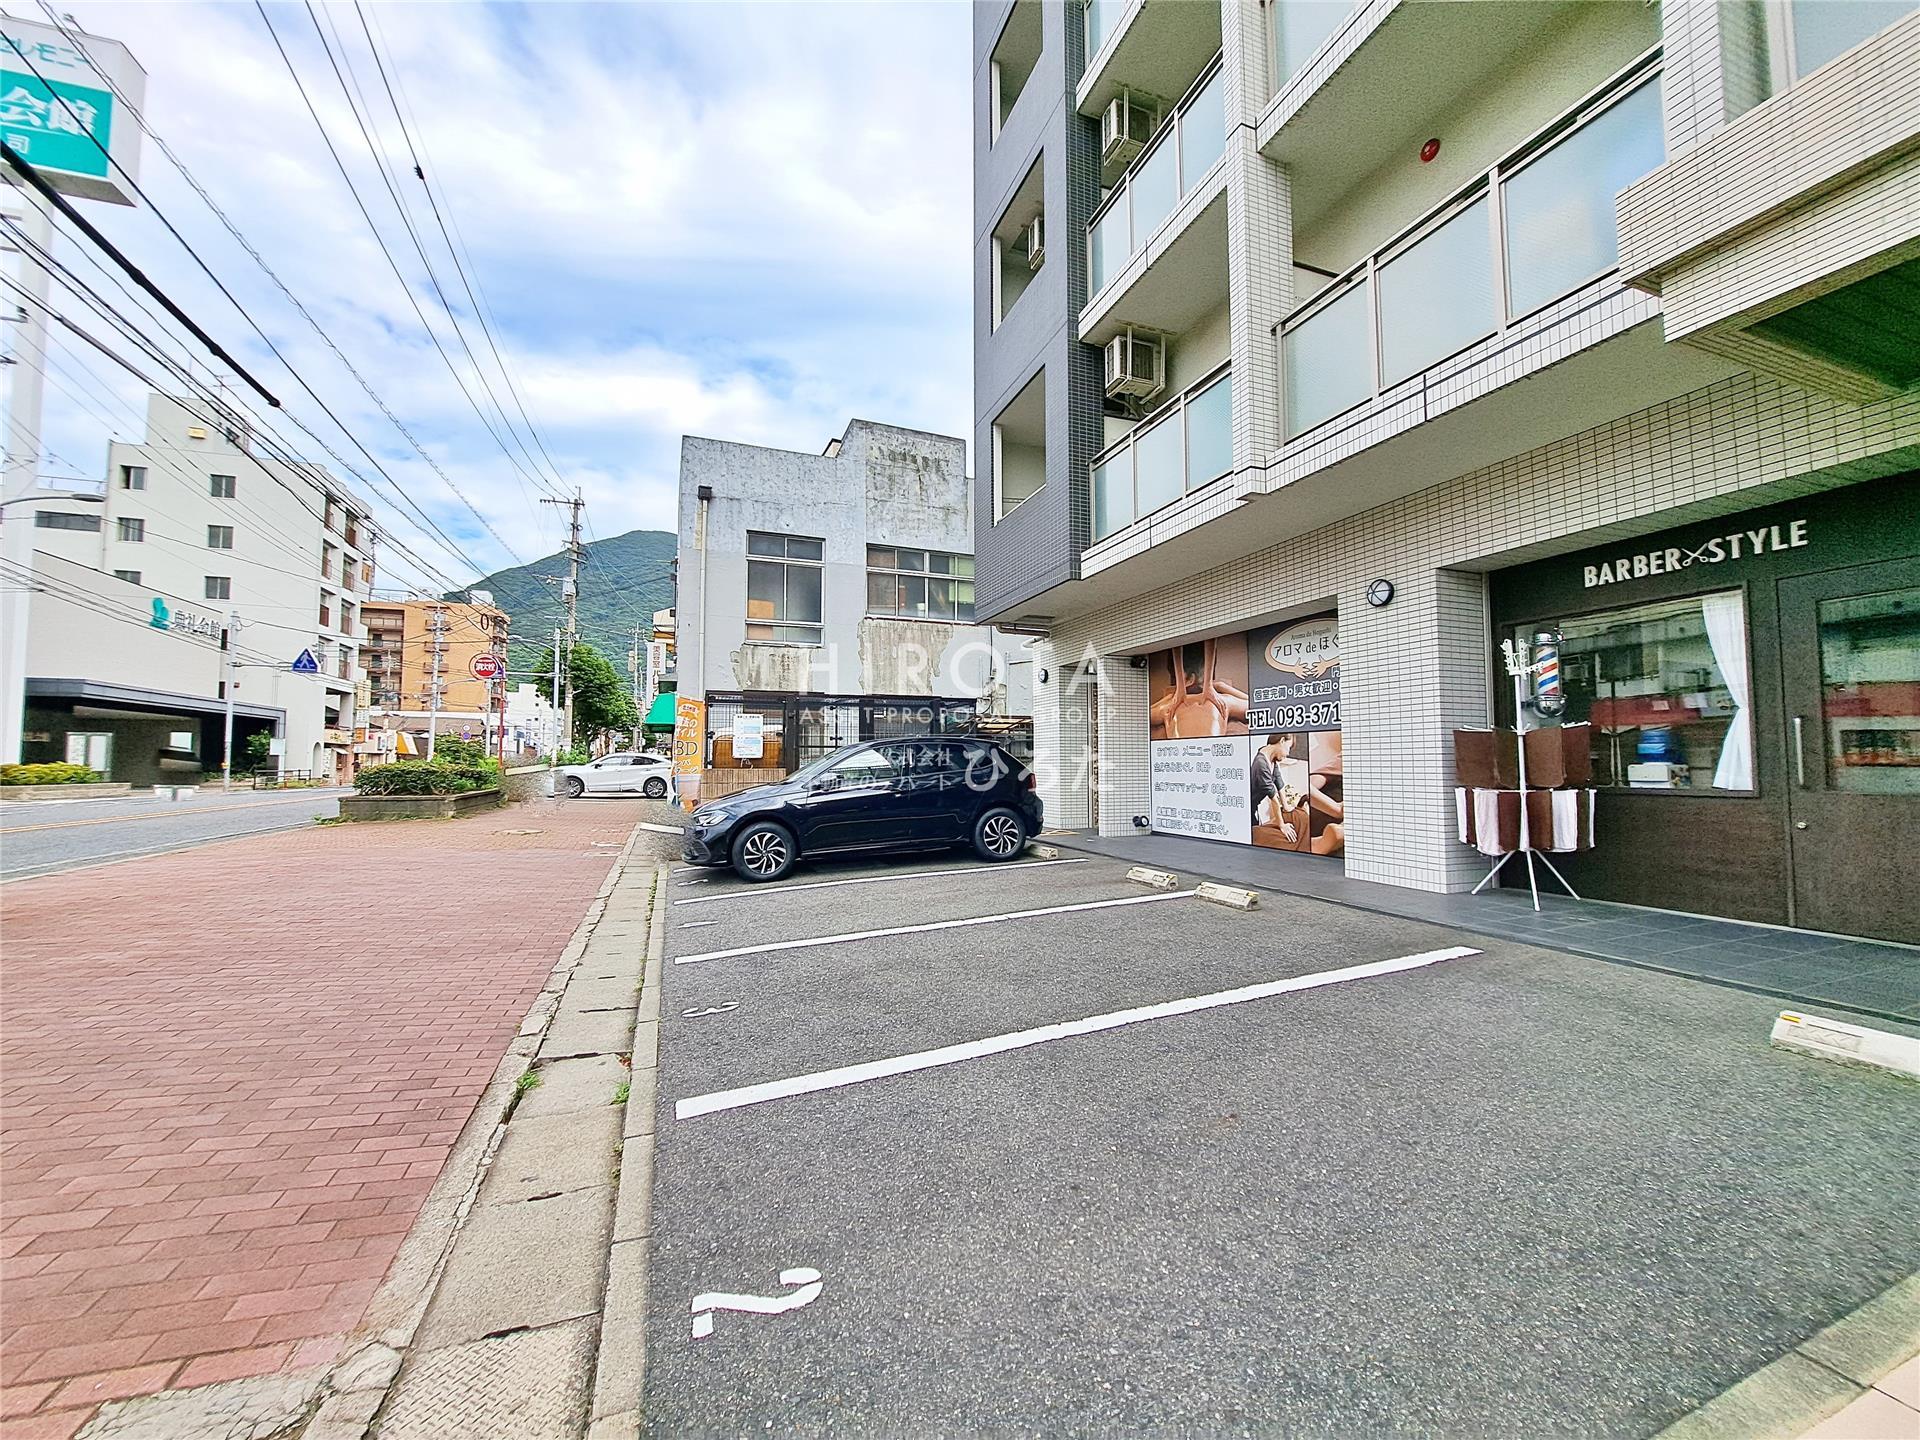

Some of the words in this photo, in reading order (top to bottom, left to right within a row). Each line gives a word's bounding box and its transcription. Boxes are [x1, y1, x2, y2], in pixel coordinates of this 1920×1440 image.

[1583, 548, 1683, 588] BARBER
[1707, 519, 1809, 563] STYLE
[1274, 643, 1302, 658] アロマ
[1305, 641, 1317, 653] de
[1247, 709, 1274, 729] TEL
[673, 740, 698, 756] BD
[691, 1266, 823, 1339] 2
